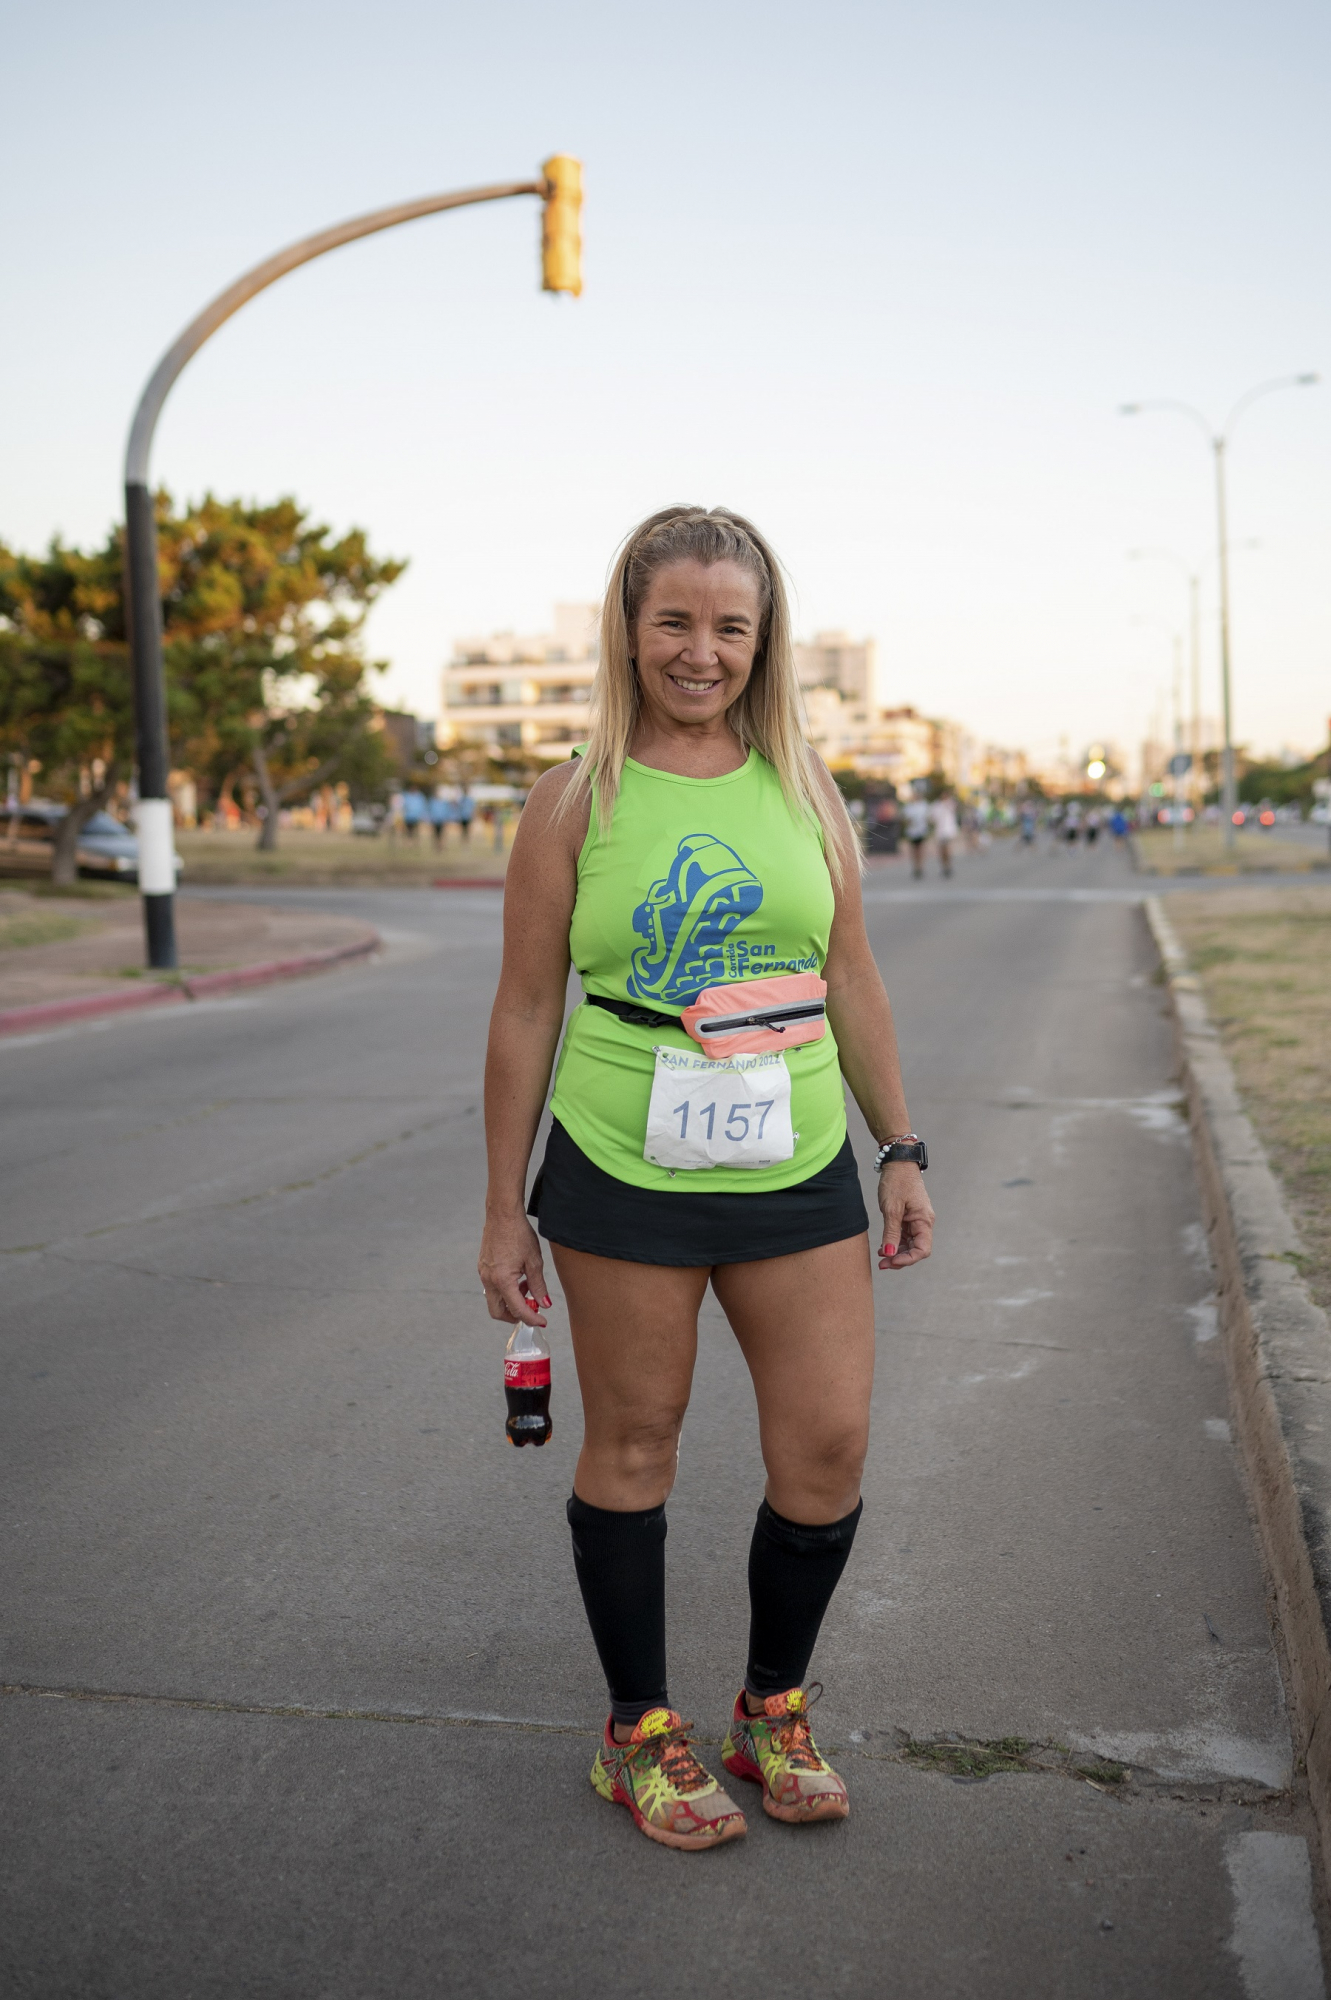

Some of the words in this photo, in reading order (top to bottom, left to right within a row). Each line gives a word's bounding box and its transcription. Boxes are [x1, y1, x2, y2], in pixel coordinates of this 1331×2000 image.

[726, 942, 737, 979] Corrida
[736, 940, 776, 958] San
[737, 951, 818, 978] Fernando
[662, 1054, 689, 1068] SAN
[759, 1054, 781, 1067] 2022
[673, 1099, 775, 1142] 1157
